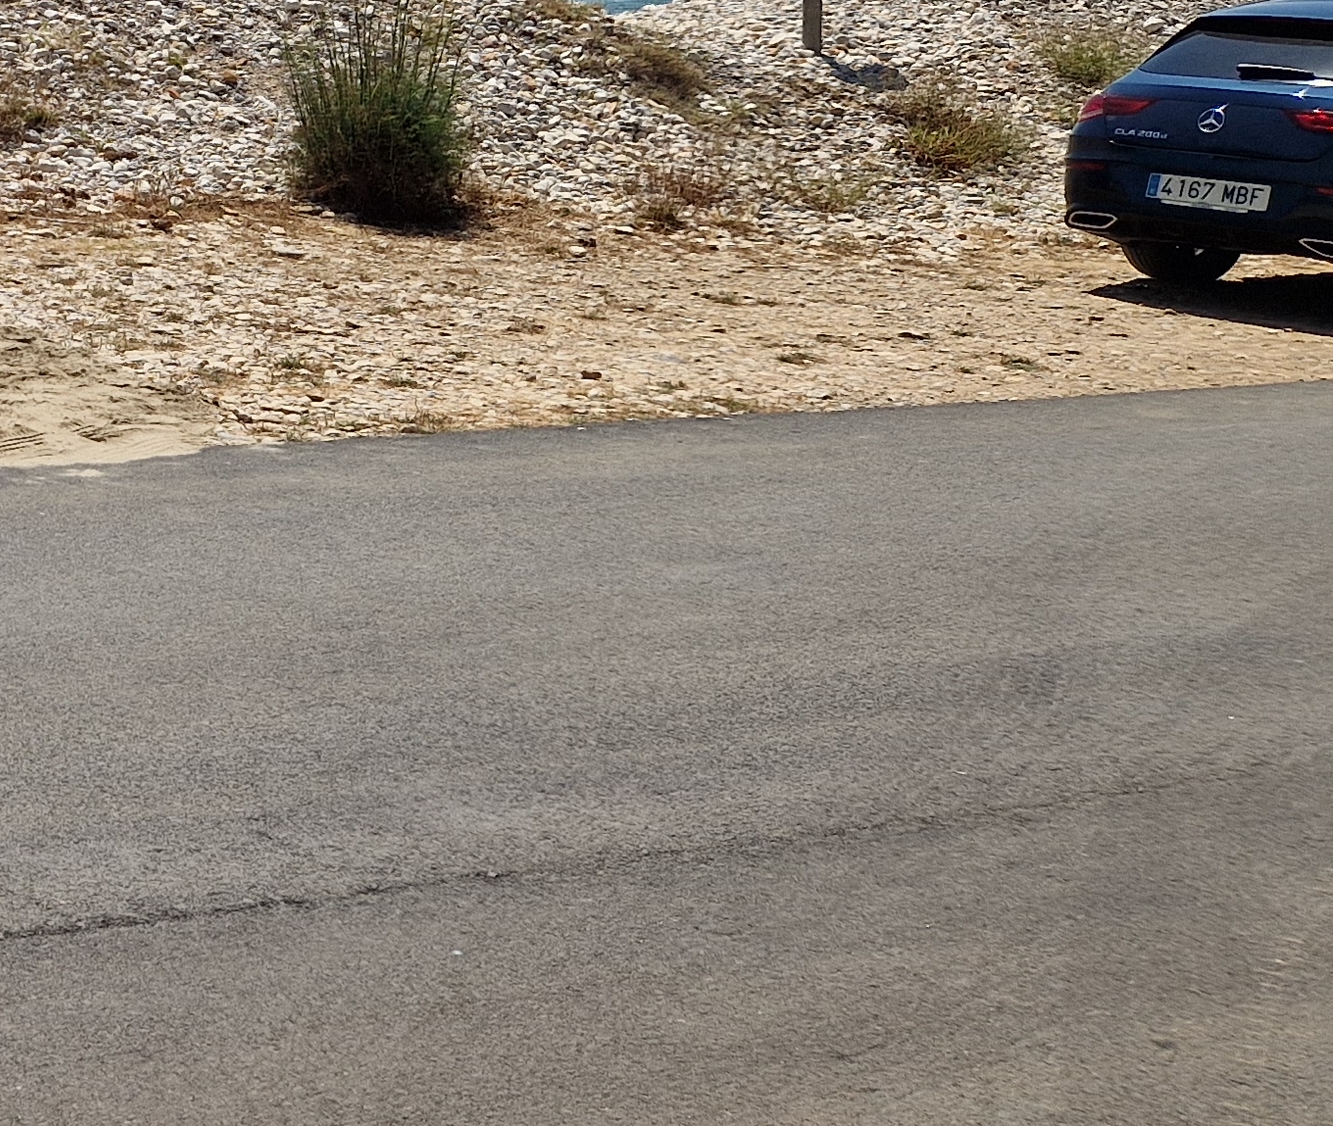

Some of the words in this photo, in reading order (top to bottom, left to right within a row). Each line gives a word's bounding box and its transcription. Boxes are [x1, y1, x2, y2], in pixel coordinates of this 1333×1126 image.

[1114, 127, 1136, 136] CLA
[1161, 177, 1216, 200] 4167
[1221, 184, 1265, 206] MBF
